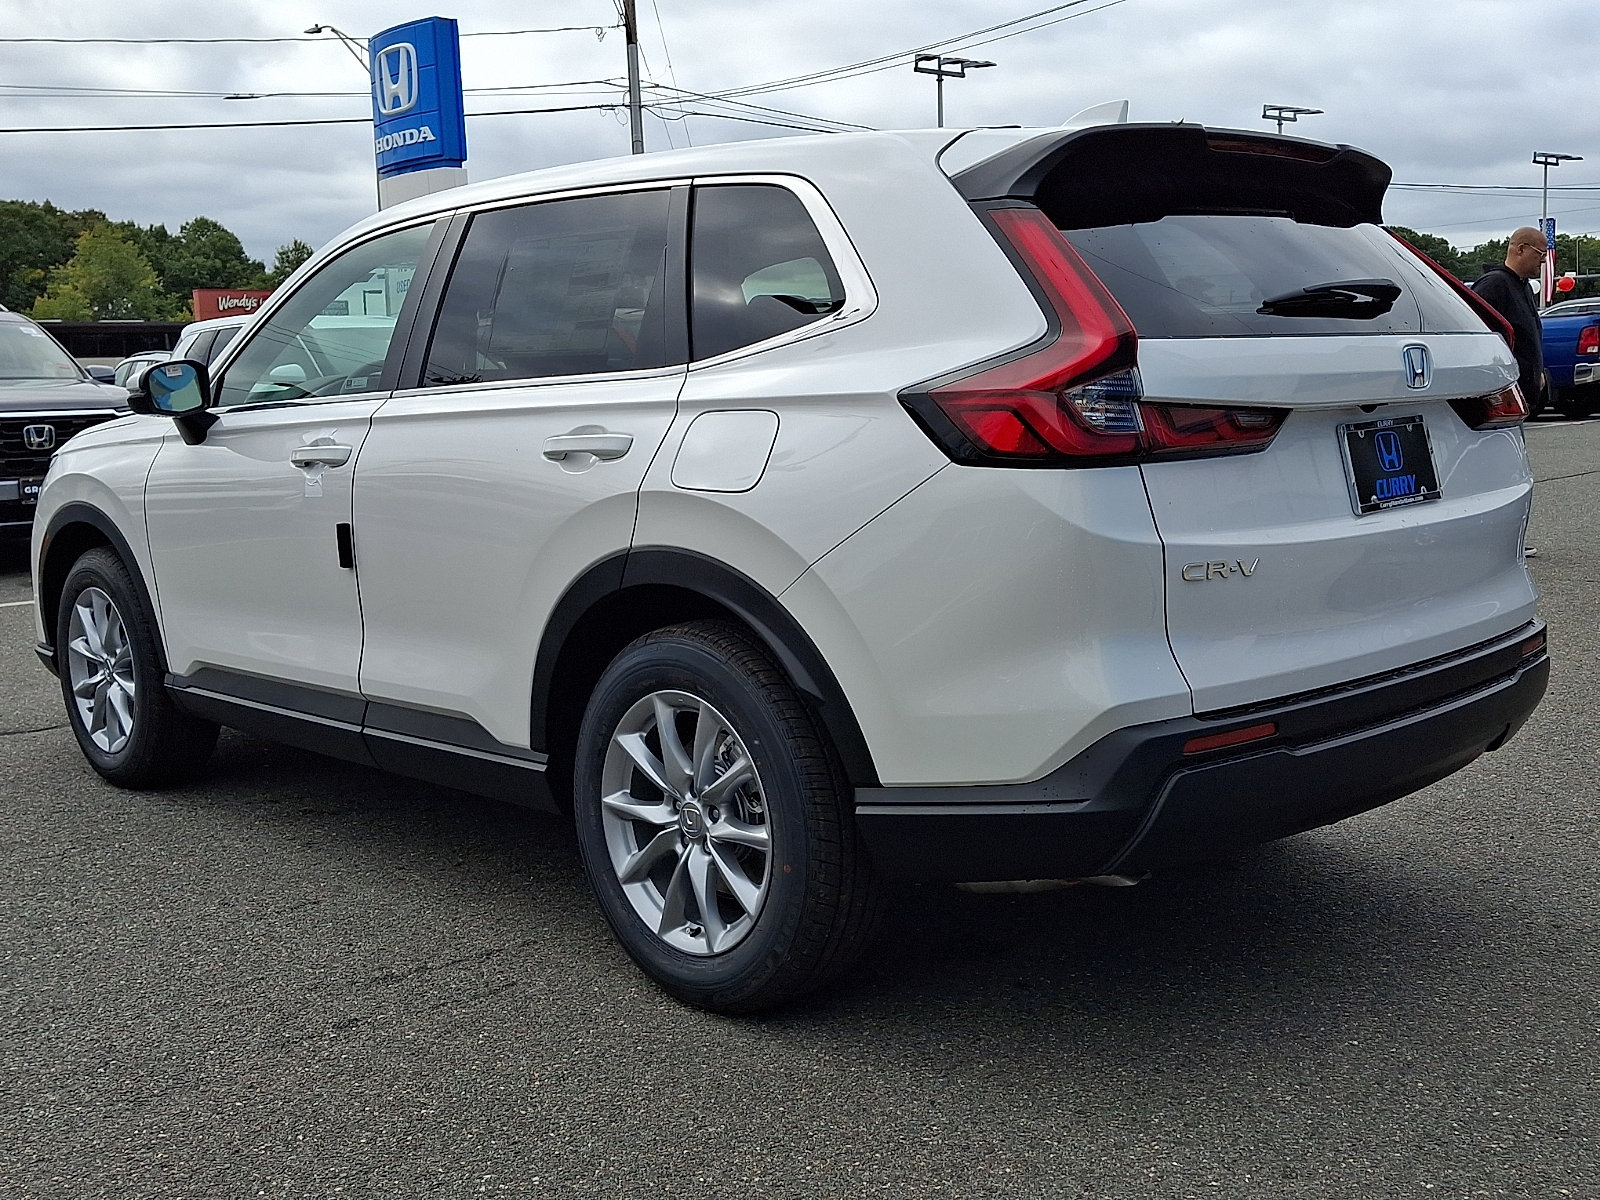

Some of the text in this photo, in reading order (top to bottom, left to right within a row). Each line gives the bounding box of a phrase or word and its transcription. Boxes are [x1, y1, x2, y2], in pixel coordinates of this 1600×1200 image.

[375, 126, 436, 154] HONDA
[218, 293, 258, 311] Wendy's
[1376, 474, 1416, 499] CURRY
[1182, 557, 1259, 581] CR-V
